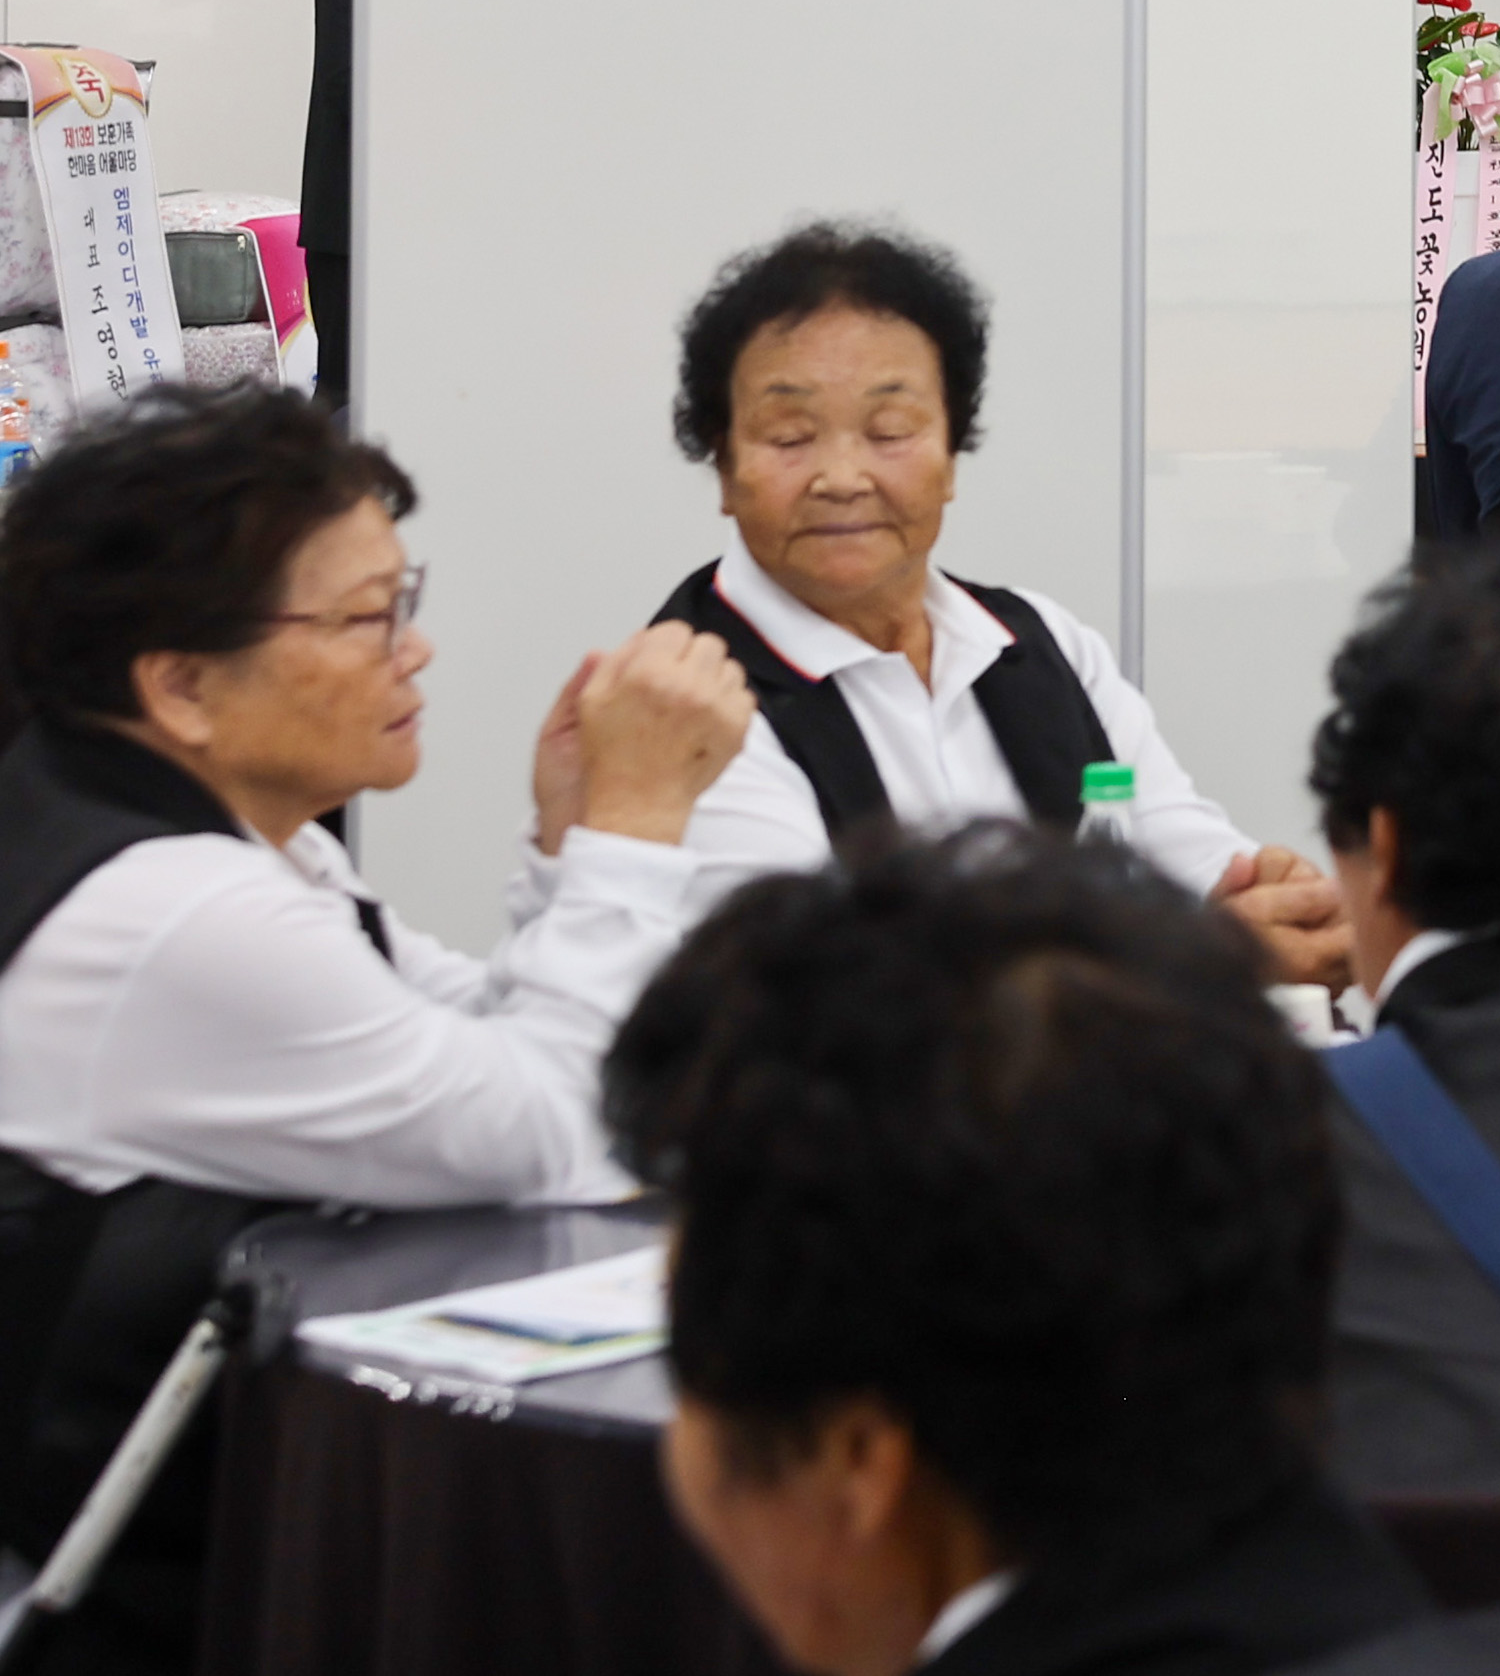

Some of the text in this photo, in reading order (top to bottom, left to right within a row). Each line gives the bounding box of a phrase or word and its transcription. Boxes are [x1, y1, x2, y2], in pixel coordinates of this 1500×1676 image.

[71, 64, 104, 103] 축
[63, 121, 135, 148] 제13회 보훈가족
[68, 149, 137, 178] 한마음 어울마당
[114, 187, 149, 339] 엠제이디개발
